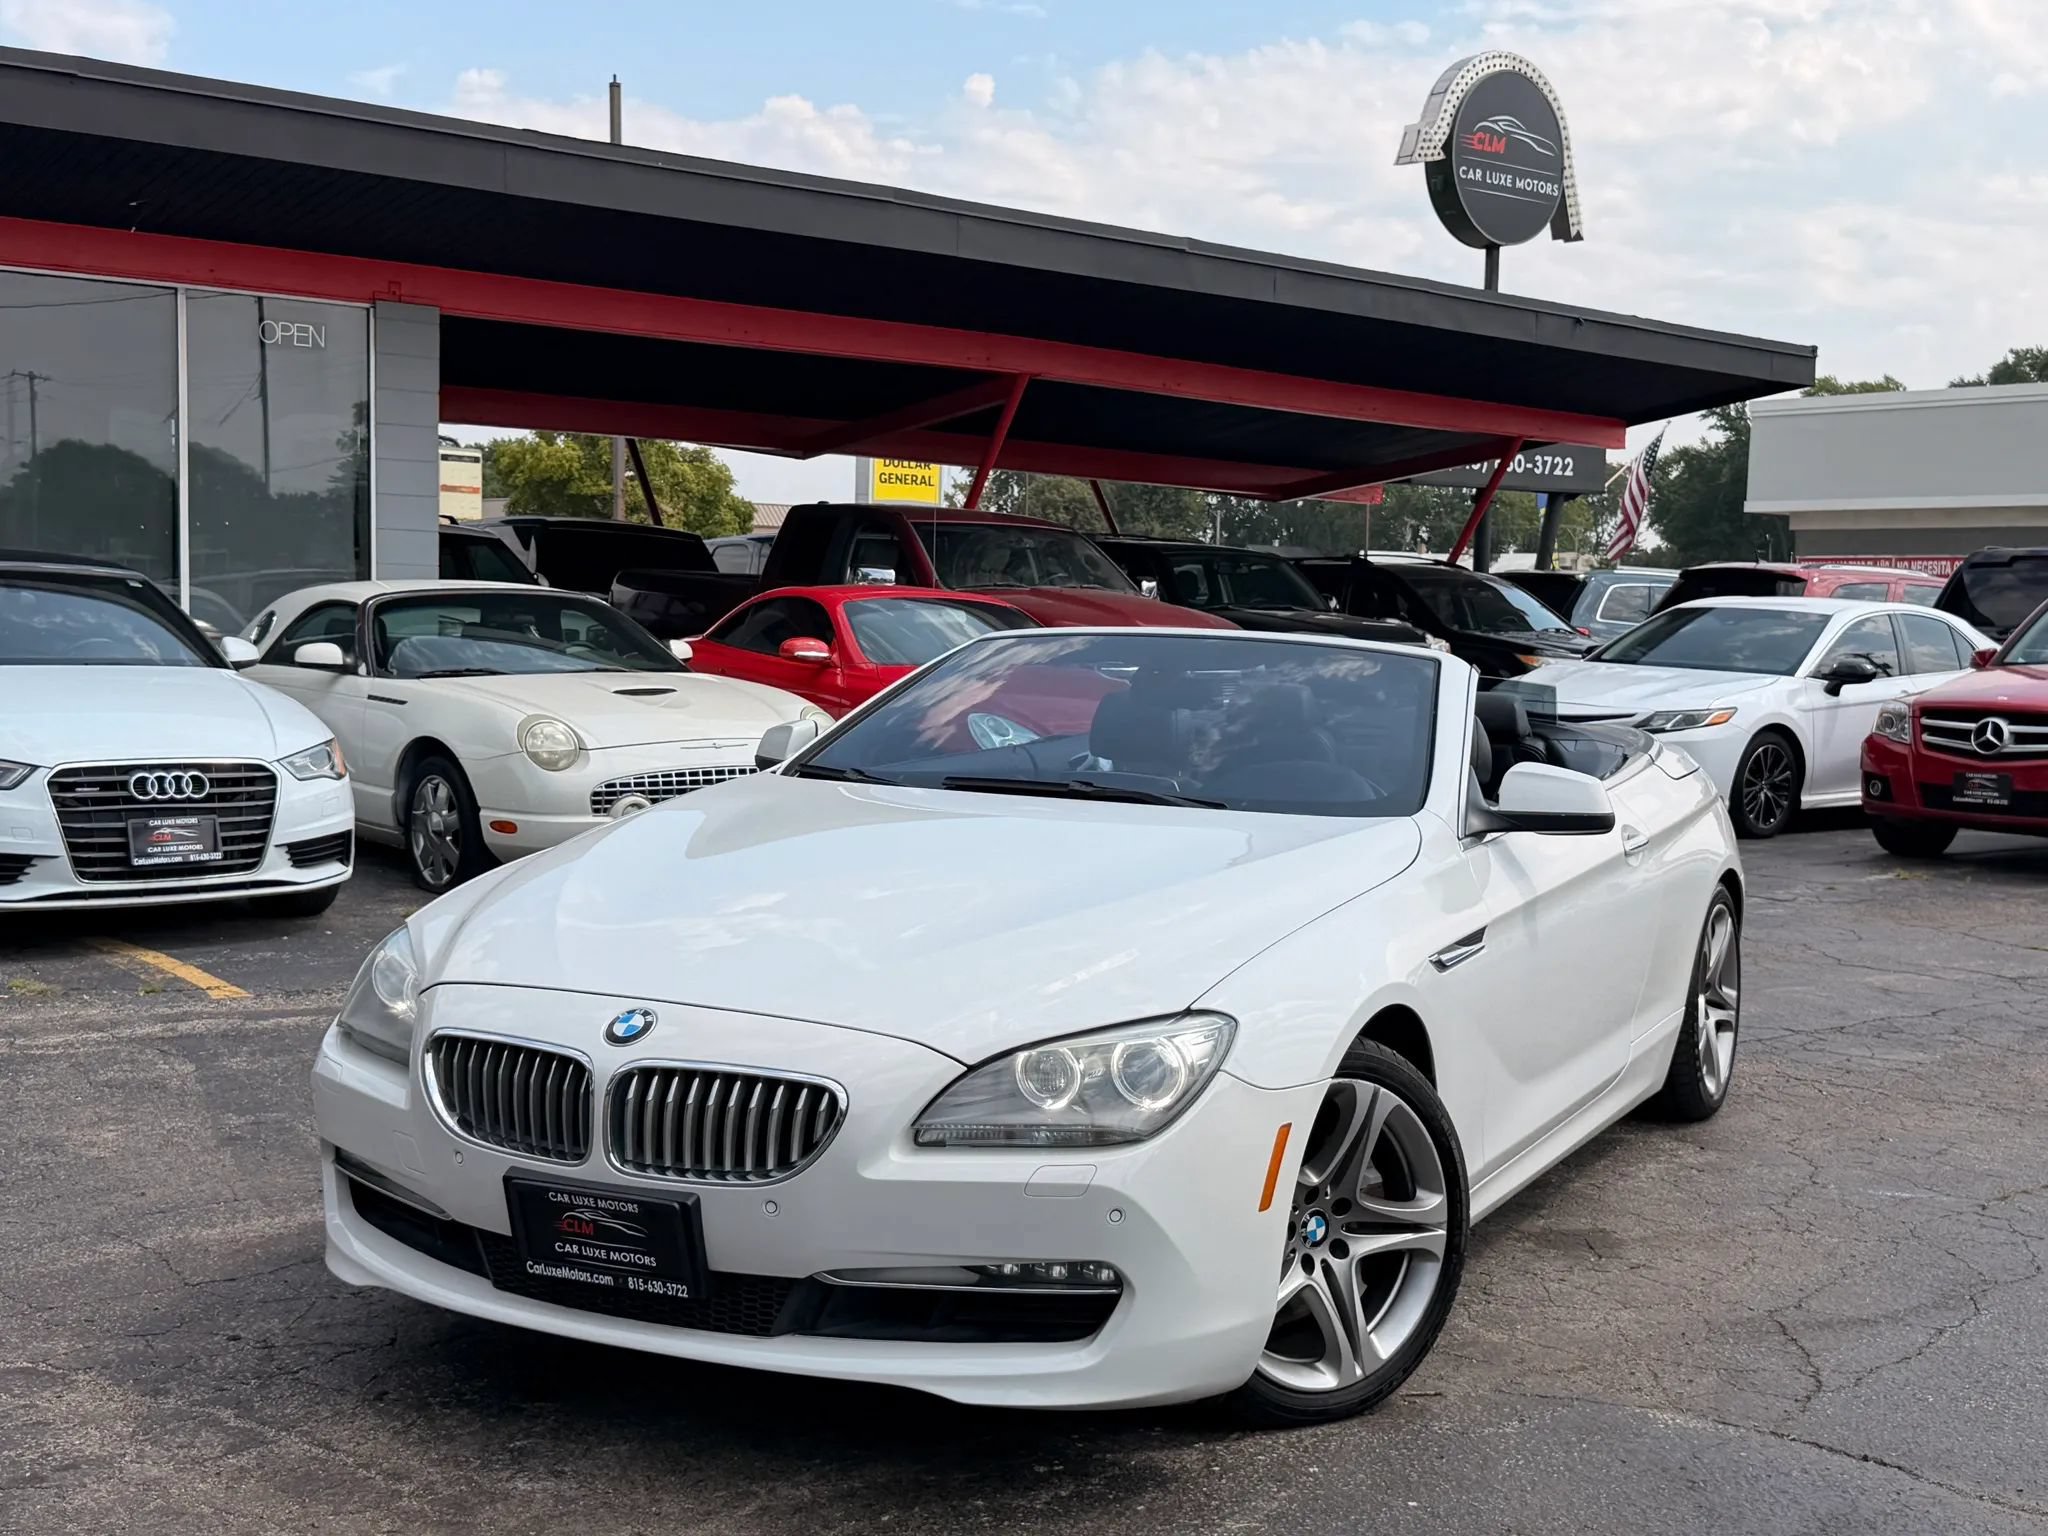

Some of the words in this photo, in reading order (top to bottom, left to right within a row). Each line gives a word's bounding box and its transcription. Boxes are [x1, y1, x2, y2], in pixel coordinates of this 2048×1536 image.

[1471, 131, 1507, 154] CLM
[1459, 166, 1482, 181] CAR
[1486, 170, 1512, 187] LUXE
[1515, 175, 1559, 197] MOTORS
[259, 320, 325, 348] OPEN
[883, 459, 931, 470] DOLLAR
[879, 472, 935, 486] GENERAL
[548, 1191, 570, 1204] CAR
[571, 1194, 596, 1207] LUXE
[597, 1199, 639, 1213] MOTORS
[562, 1218, 594, 1236] CLM
[555, 1242, 580, 1254] CAR
[582, 1246, 607, 1259] LUXE
[609, 1251, 657, 1266] MOTORS
[526, 1260, 614, 1286] CarLuxeMotors.com
[627, 1276, 689, 1298] 815-630-3722
